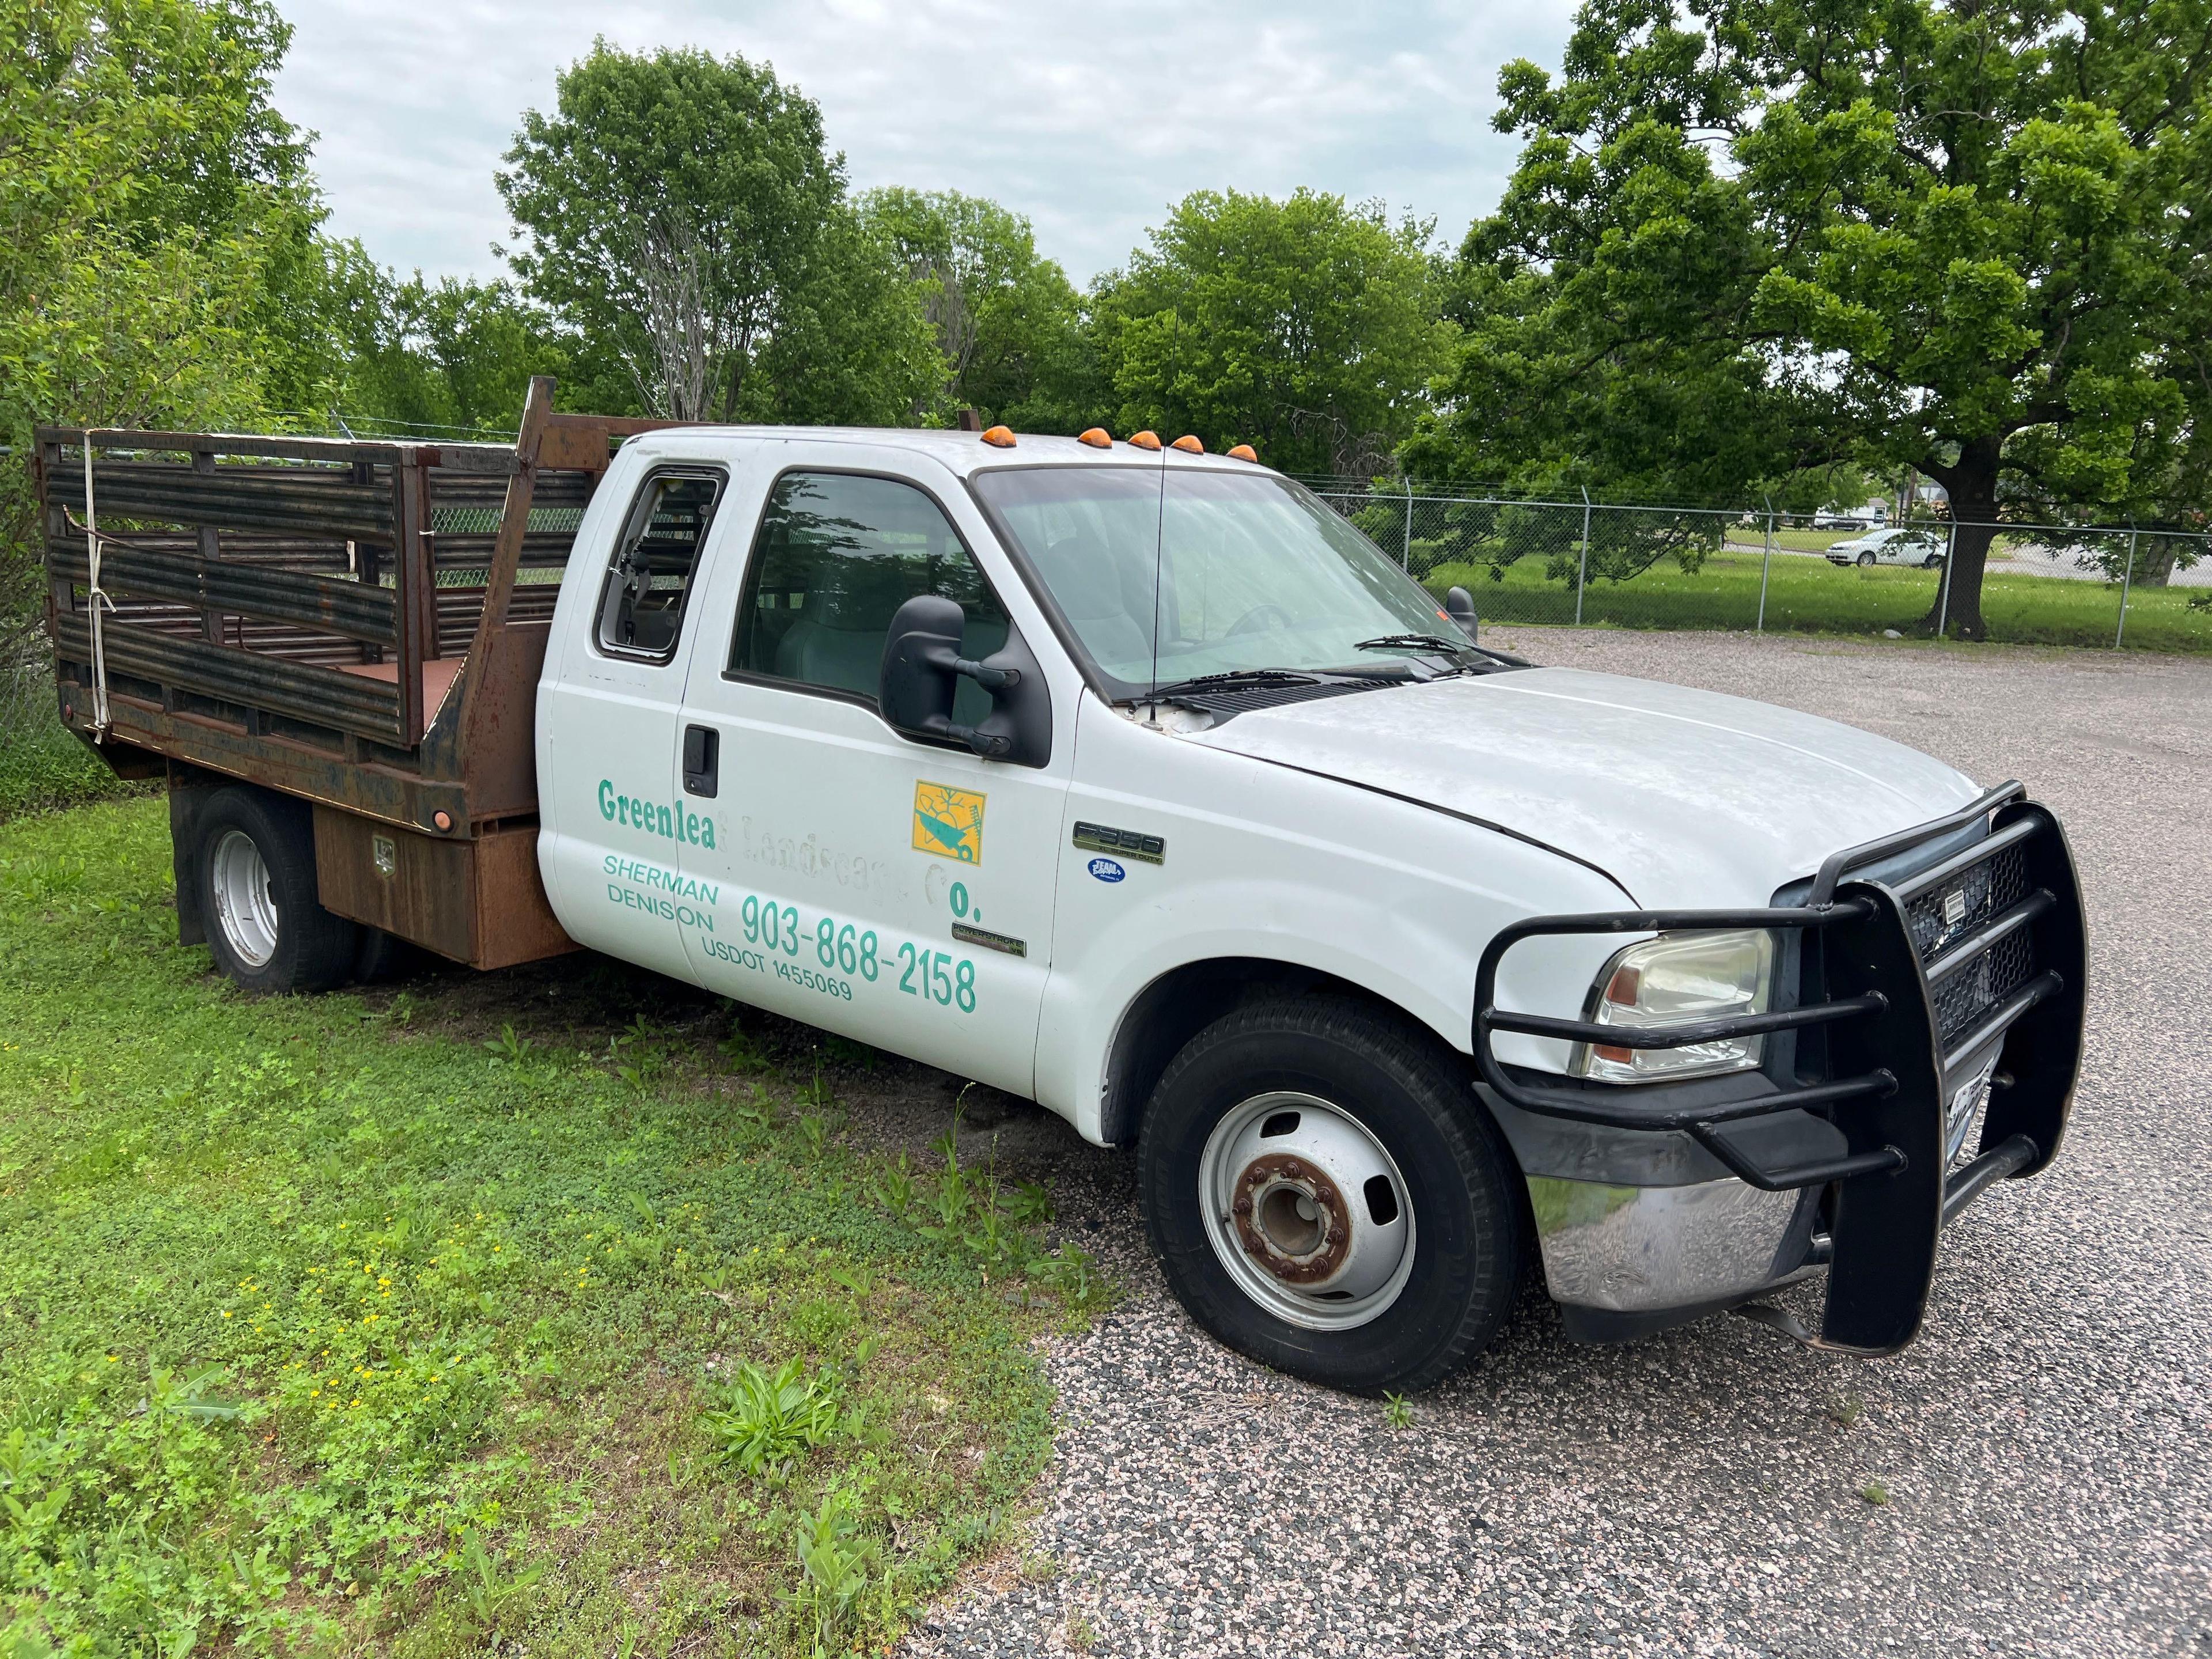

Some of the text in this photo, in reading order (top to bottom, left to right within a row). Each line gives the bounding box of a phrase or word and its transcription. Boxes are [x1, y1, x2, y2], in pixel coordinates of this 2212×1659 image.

[603, 855, 719, 905] SHERMAN
[1095, 860, 1116, 871] TEAM
[1111, 849, 1137, 858] SUPER
[1138, 854, 1160, 863] DUTY
[608, 884, 714, 932] DENISON
[702, 937, 853, 1001] USDOT 1455069
[741, 895, 976, 1014] 903-868-2158
